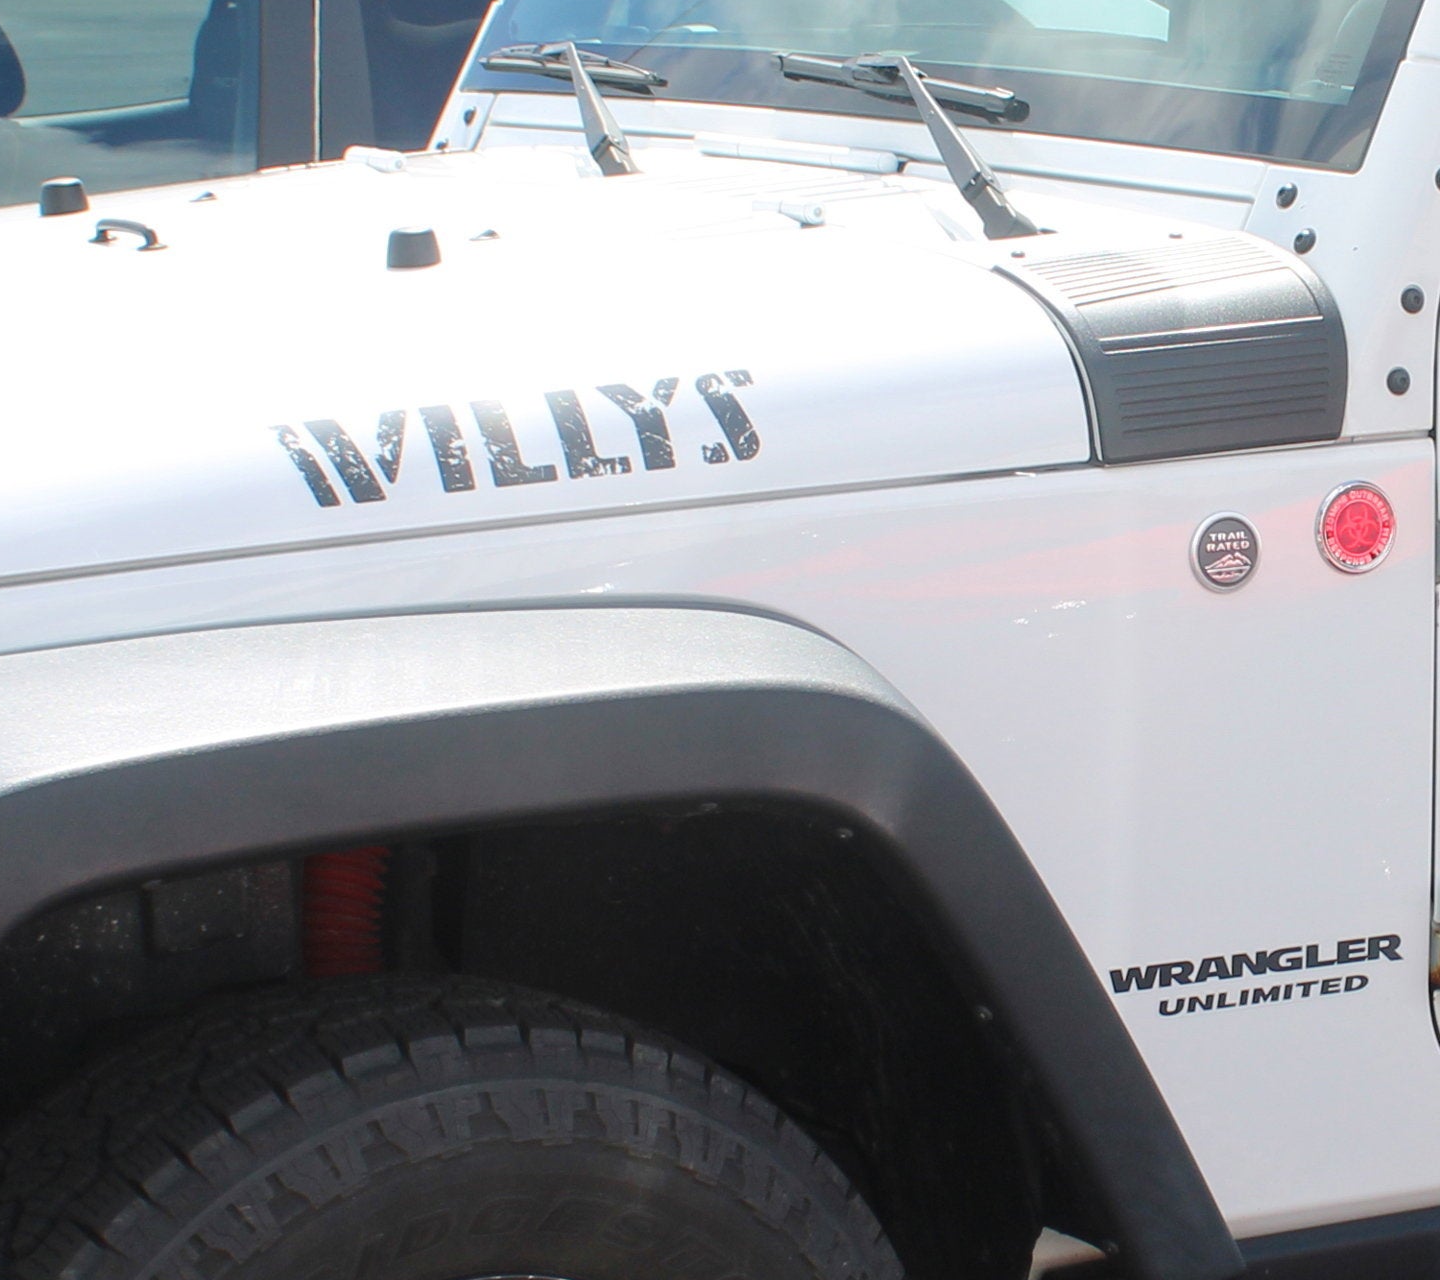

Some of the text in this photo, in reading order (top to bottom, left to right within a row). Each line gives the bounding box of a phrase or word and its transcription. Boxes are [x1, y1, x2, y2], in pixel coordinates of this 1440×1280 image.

[268, 369, 761, 508] WILLYS
[1206, 540, 1250, 552] RATED
[1208, 530, 1248, 542] TRAIL
[1109, 933, 1404, 994] WRANGLER
[1158, 974, 1370, 1017] UNLIMITED
